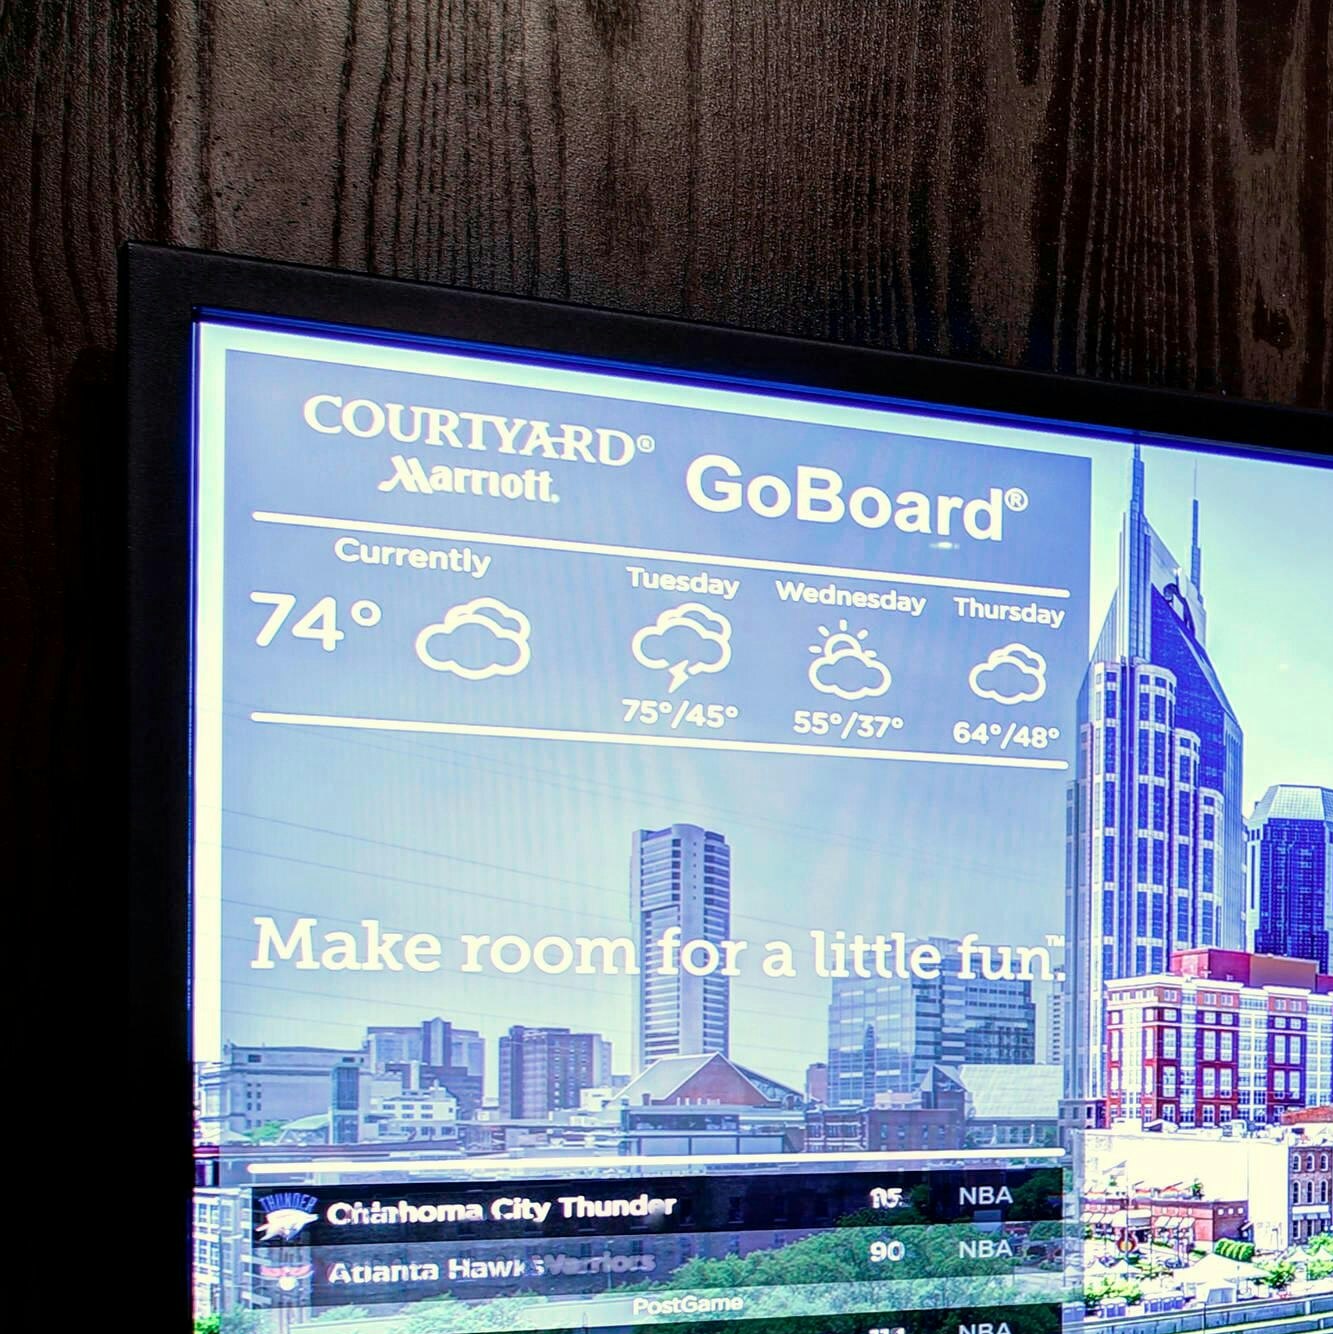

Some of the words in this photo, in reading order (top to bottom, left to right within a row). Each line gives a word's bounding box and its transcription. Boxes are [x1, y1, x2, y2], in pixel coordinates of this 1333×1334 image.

[334, 537, 492, 578] Currently
[626, 567, 740, 600] Tuesday
[776, 580, 926, 617] Wednesday
[249, 591, 382, 652] 74°
[953, 597, 1065, 629] Thursday
[622, 698, 739, 729] 75°/45°
[793, 711, 904, 740] 55°/37°
[952, 721, 1060, 750] 64°/48°
[250, 916, 441, 972] Make
[461, 933, 641, 976] room
[656, 927, 747, 978] for
[762, 940, 796, 978] a
[811, 930, 942, 980] little
[490, 1196, 551, 1223] City
[557, 1193, 678, 1219] Thunder
[959, 1186, 1014, 1206] NBA
[869, 1240, 905, 1263] 90
[959, 1239, 1014, 1259] NBA
[632, 1294, 744, 1317] PostGame
